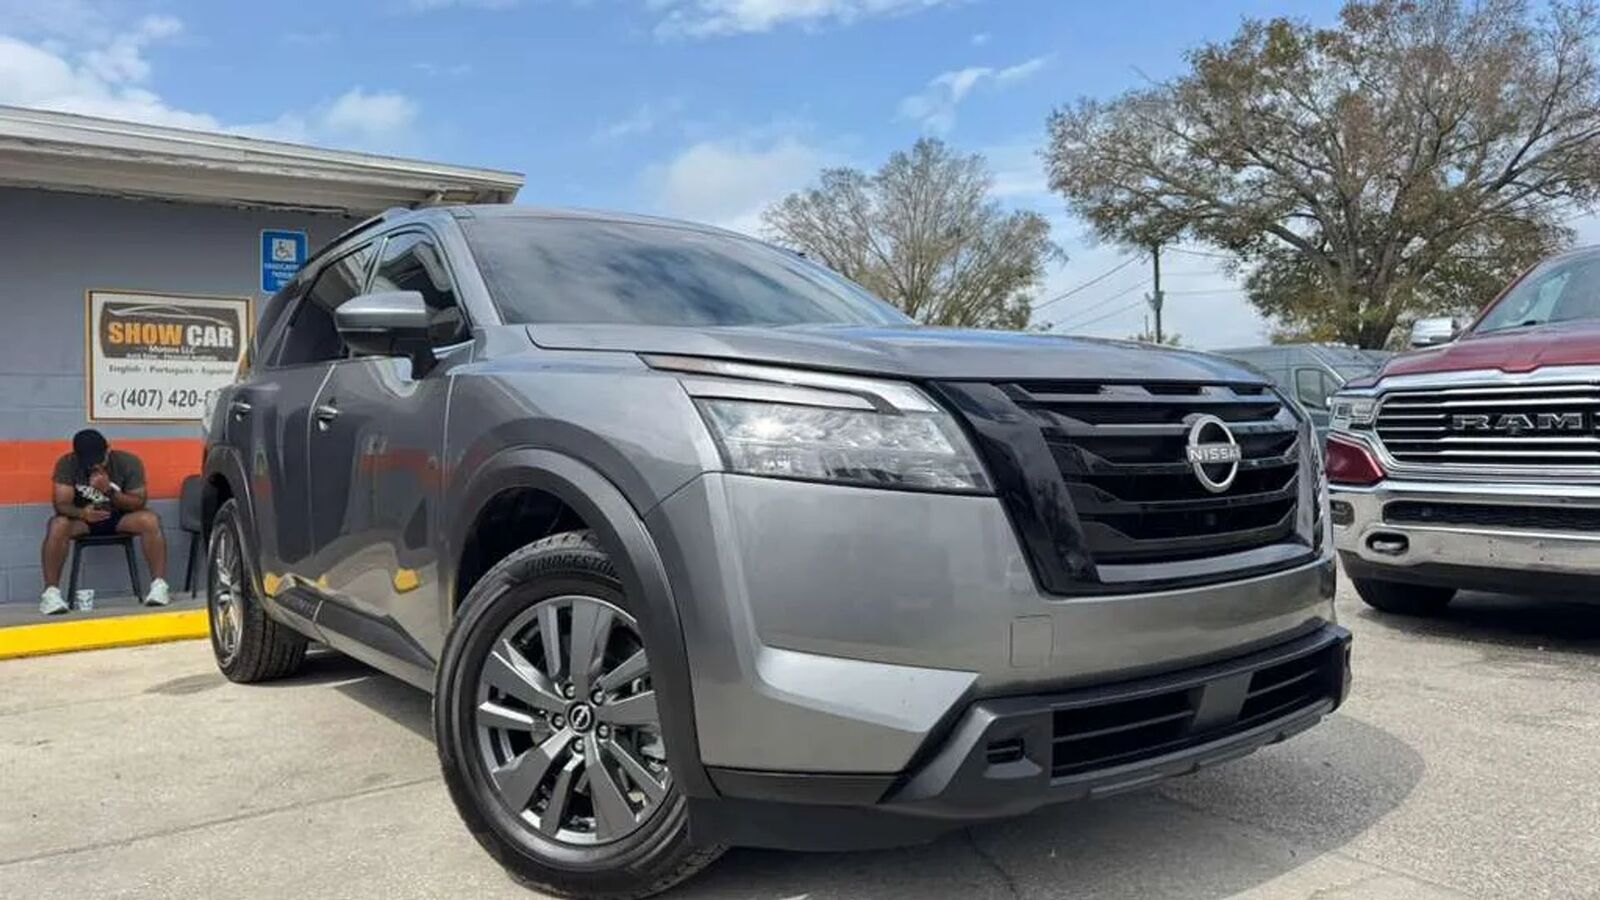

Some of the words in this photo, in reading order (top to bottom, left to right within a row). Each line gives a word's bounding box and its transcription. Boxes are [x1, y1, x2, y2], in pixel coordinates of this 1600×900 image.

[108, 322, 183, 345] SHOW
[187, 325, 233, 348] CAR
[121, 388, 163, 410] (407)
[1452, 413, 1582, 430] RAM
